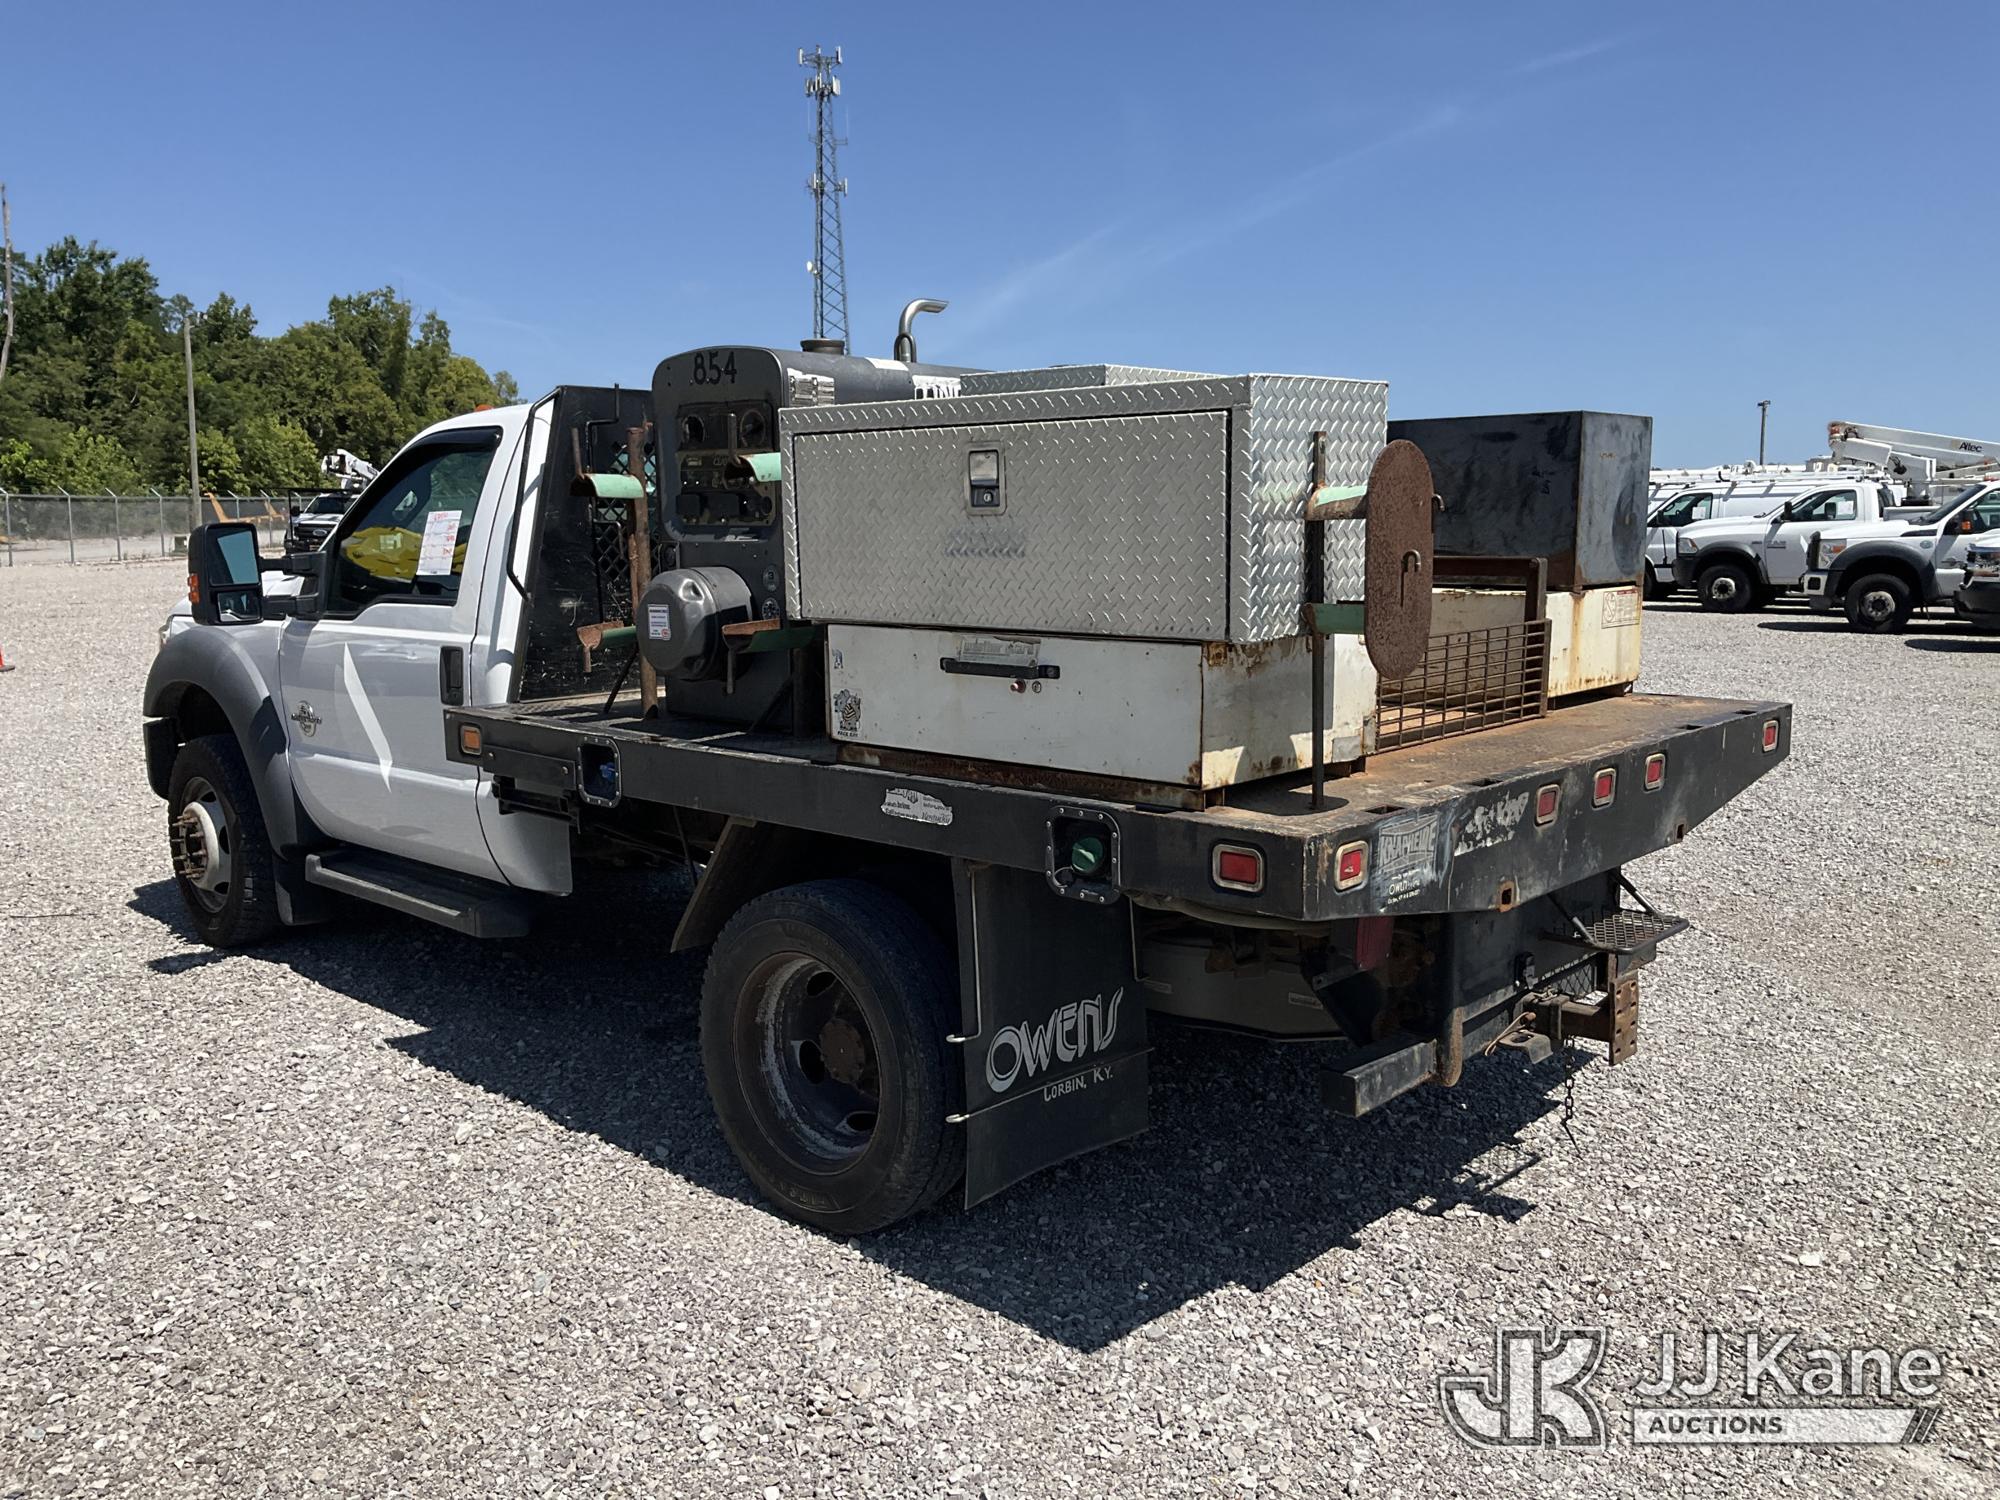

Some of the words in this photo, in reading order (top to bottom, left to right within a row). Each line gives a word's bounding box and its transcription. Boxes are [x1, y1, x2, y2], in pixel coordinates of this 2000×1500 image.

[693, 351, 737, 385] 854
[1959, 441, 1983, 453] Altec
[986, 986, 1124, 1092] OWENS
